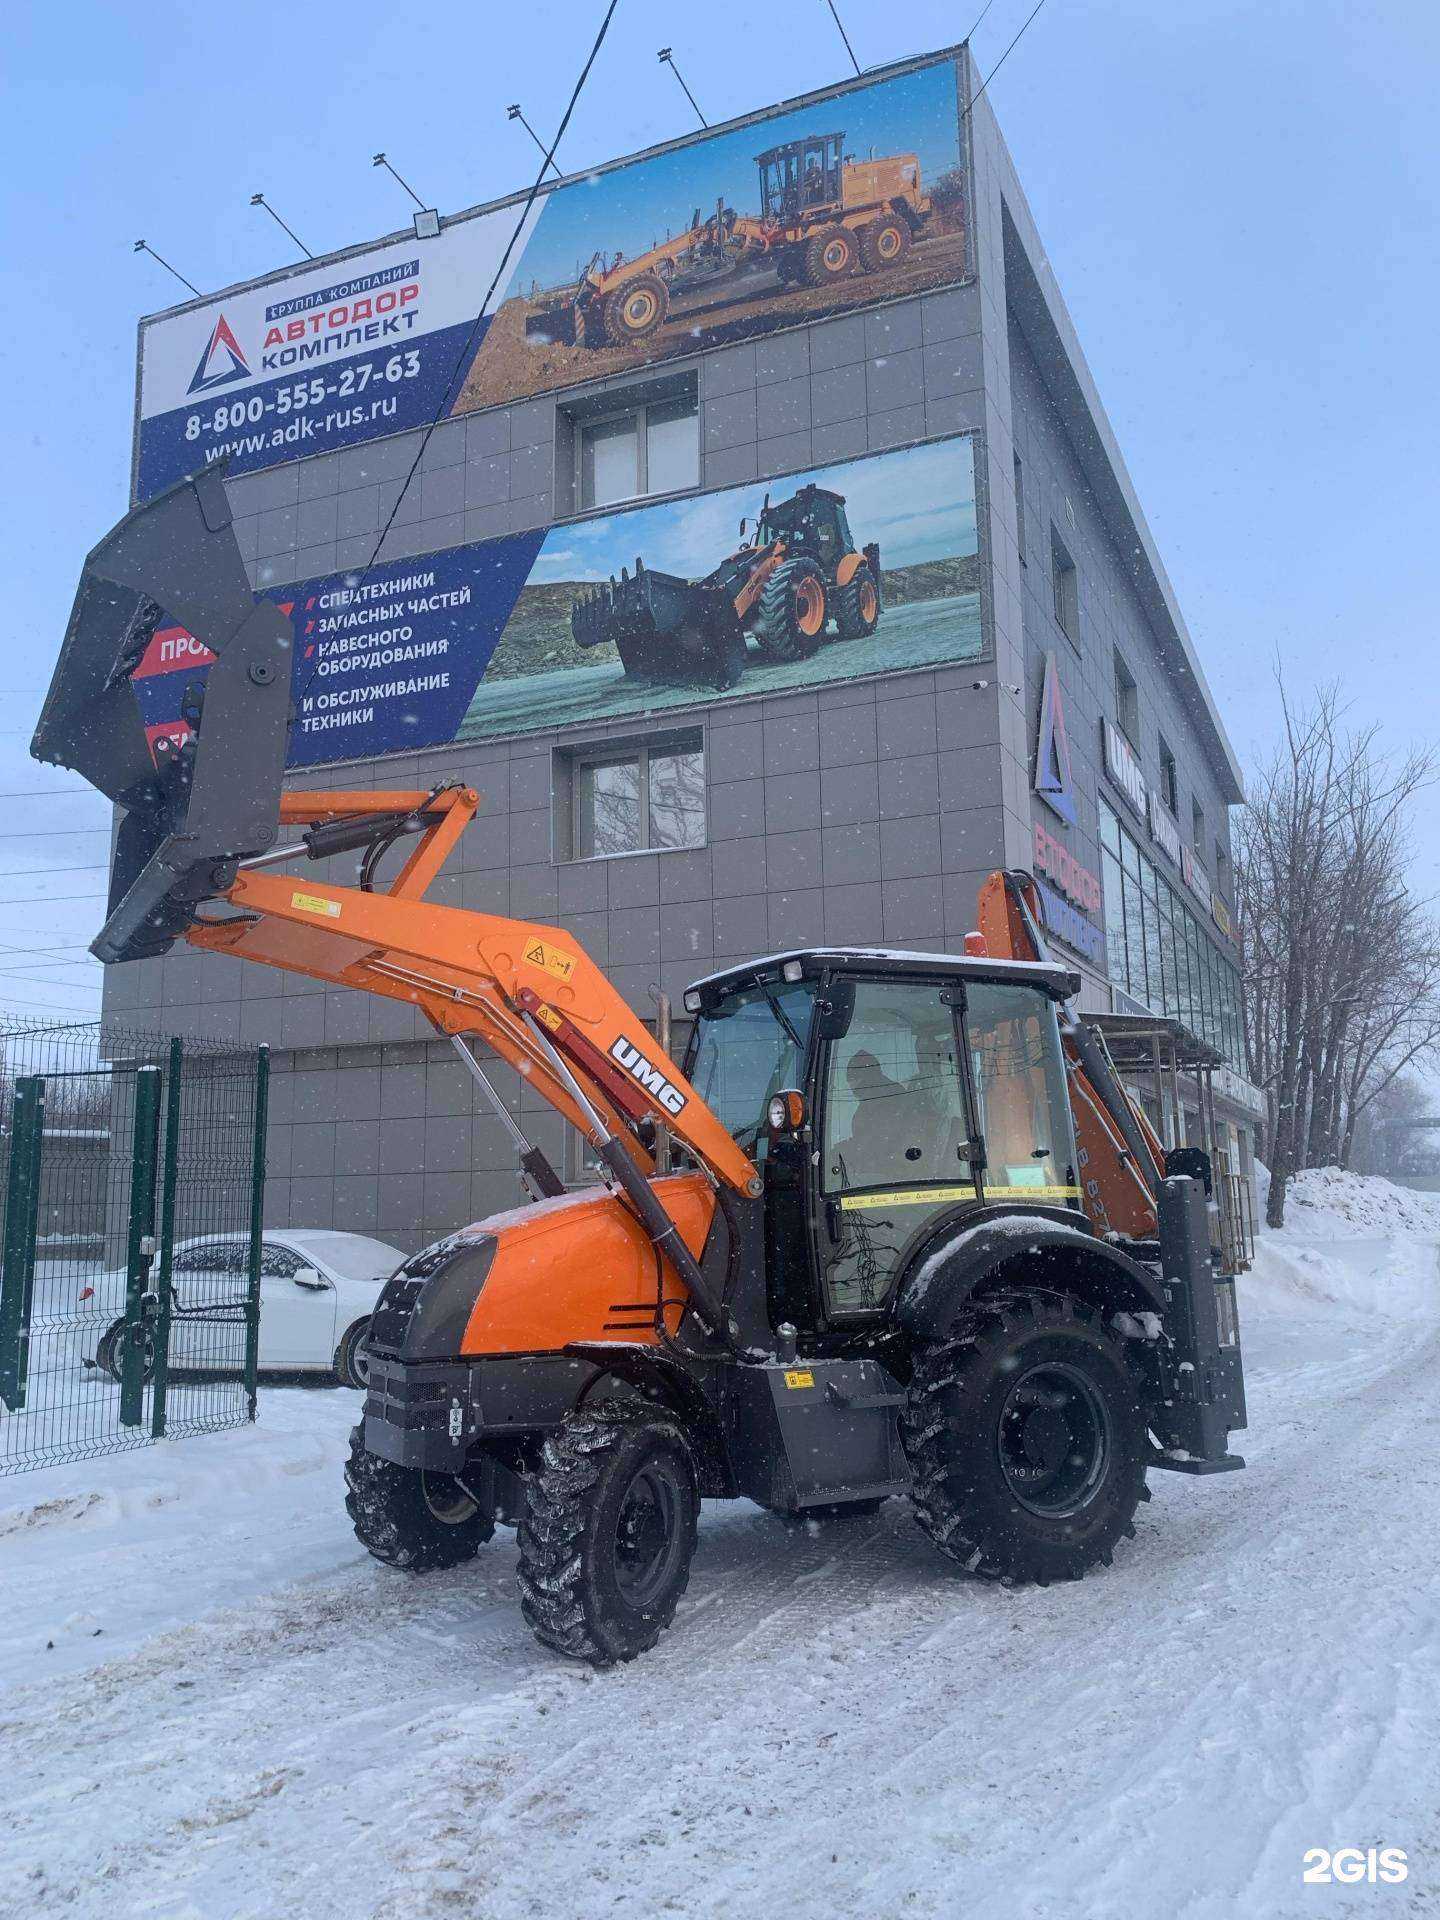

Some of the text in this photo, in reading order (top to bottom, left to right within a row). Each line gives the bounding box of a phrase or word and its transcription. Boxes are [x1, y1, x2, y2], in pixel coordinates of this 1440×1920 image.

[270, 262, 415, 318] ГРУППА КОМПАНИЙ
[262, 310, 419, 370] КОМПЛЕКТ
[263, 284, 420, 348] АВТОДОР
[185, 350, 421, 441] 8-800-555-27-63
[204, 395, 397, 463] www.adk-rus.ru
[318, 586, 471, 633] ЗАПАСНЫХ ЧАСТЕЙ
[319, 572, 435, 609] СПЕЦТЕХНИКИ
[318, 626, 412, 657] НАВЕСНОГО
[318, 639, 449, 676] ОБОРУДОВАНИЯ
[302, 673, 450, 712] И ОБСЛУЖИВАНИЕ
[302, 708, 374, 733] ТЕХНИКИ
[612, 1037, 685, 1113] UMG
